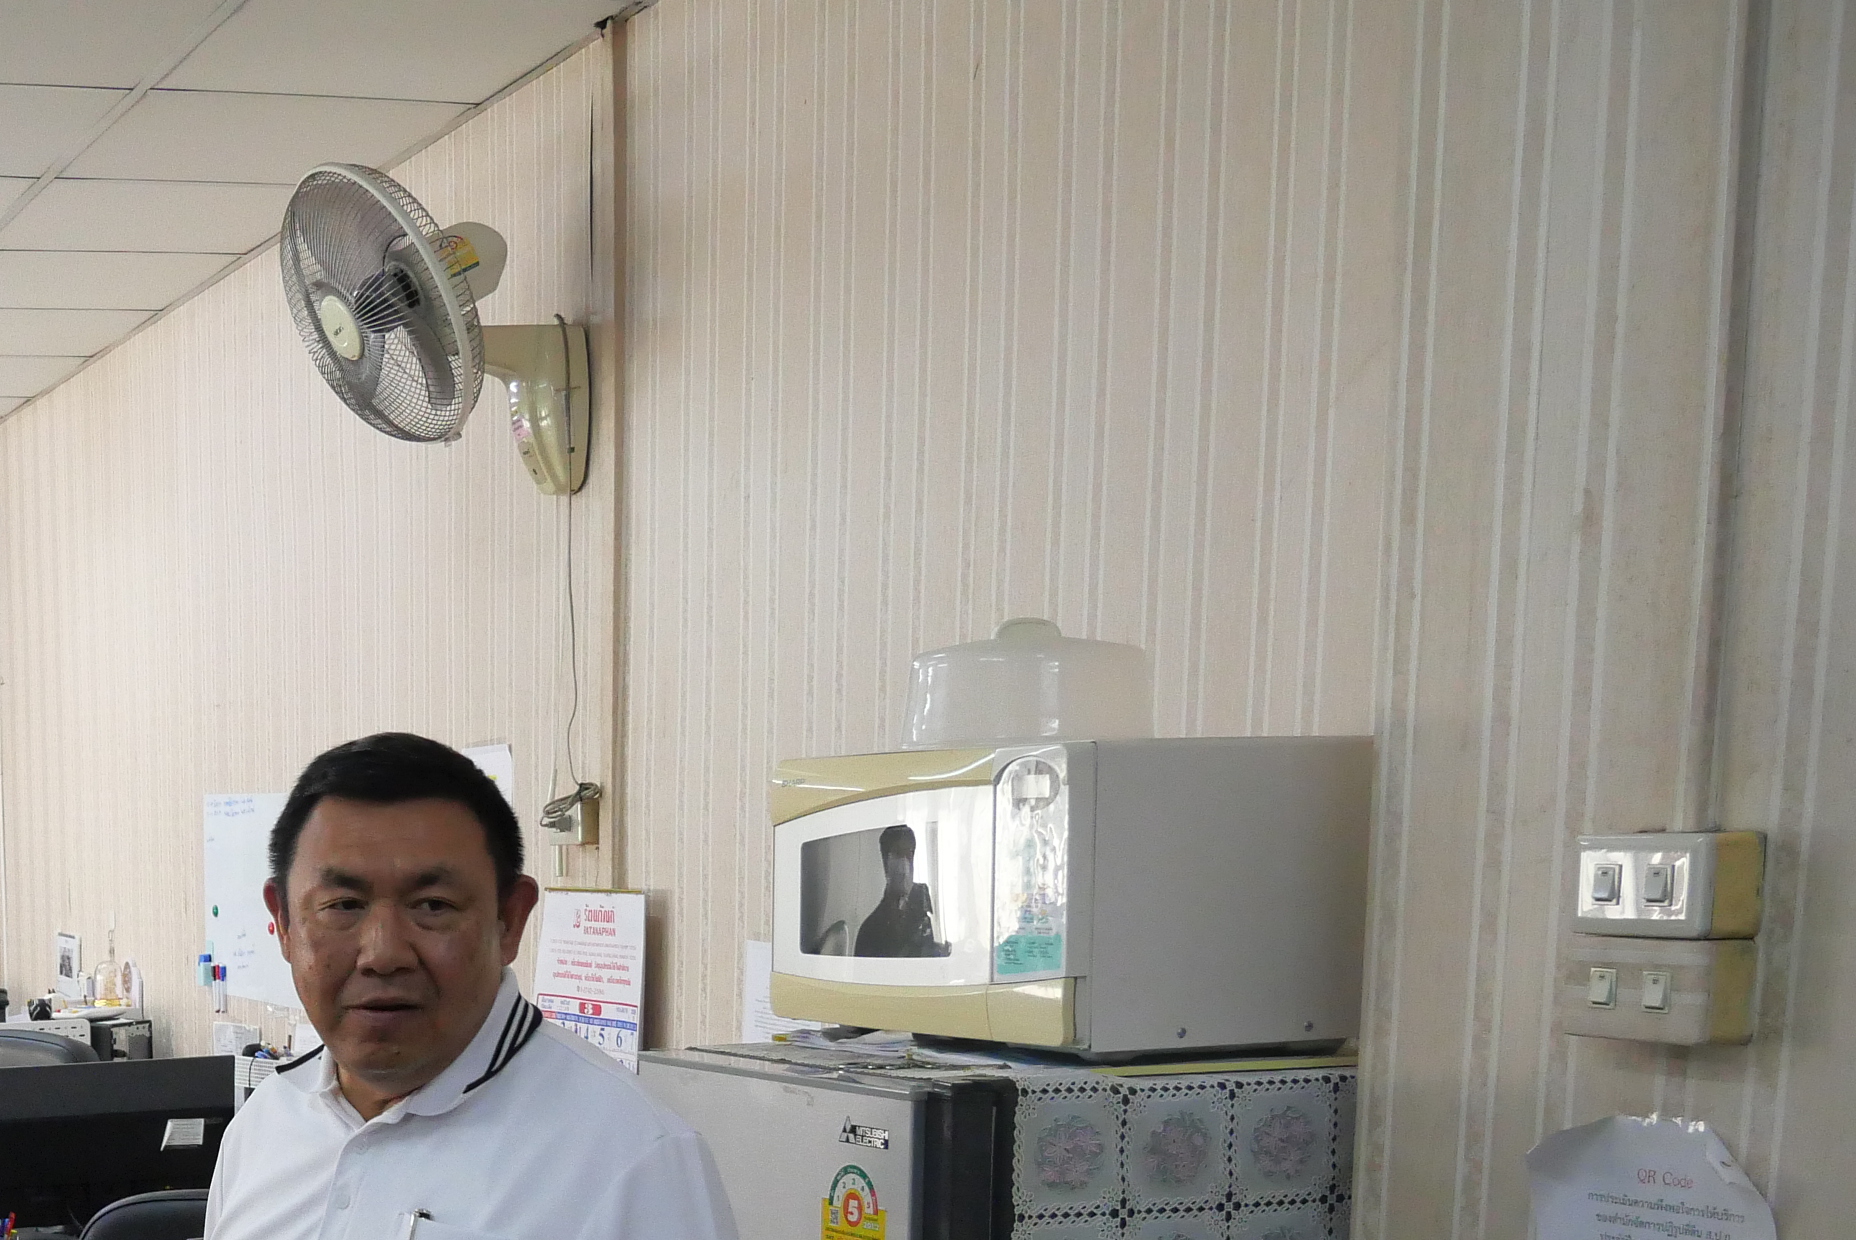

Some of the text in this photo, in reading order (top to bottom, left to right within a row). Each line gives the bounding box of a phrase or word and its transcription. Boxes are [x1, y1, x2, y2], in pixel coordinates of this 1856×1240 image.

[584, 1003, 593, 1015] 3
[598, 1028, 605, 1046] 5
[615, 1029, 623, 1048] 6
[855, 1135, 885, 1149] ELECTRIC
[1637, 1168, 1694, 1188] QR Code
[847, 1199, 859, 1222] 5
